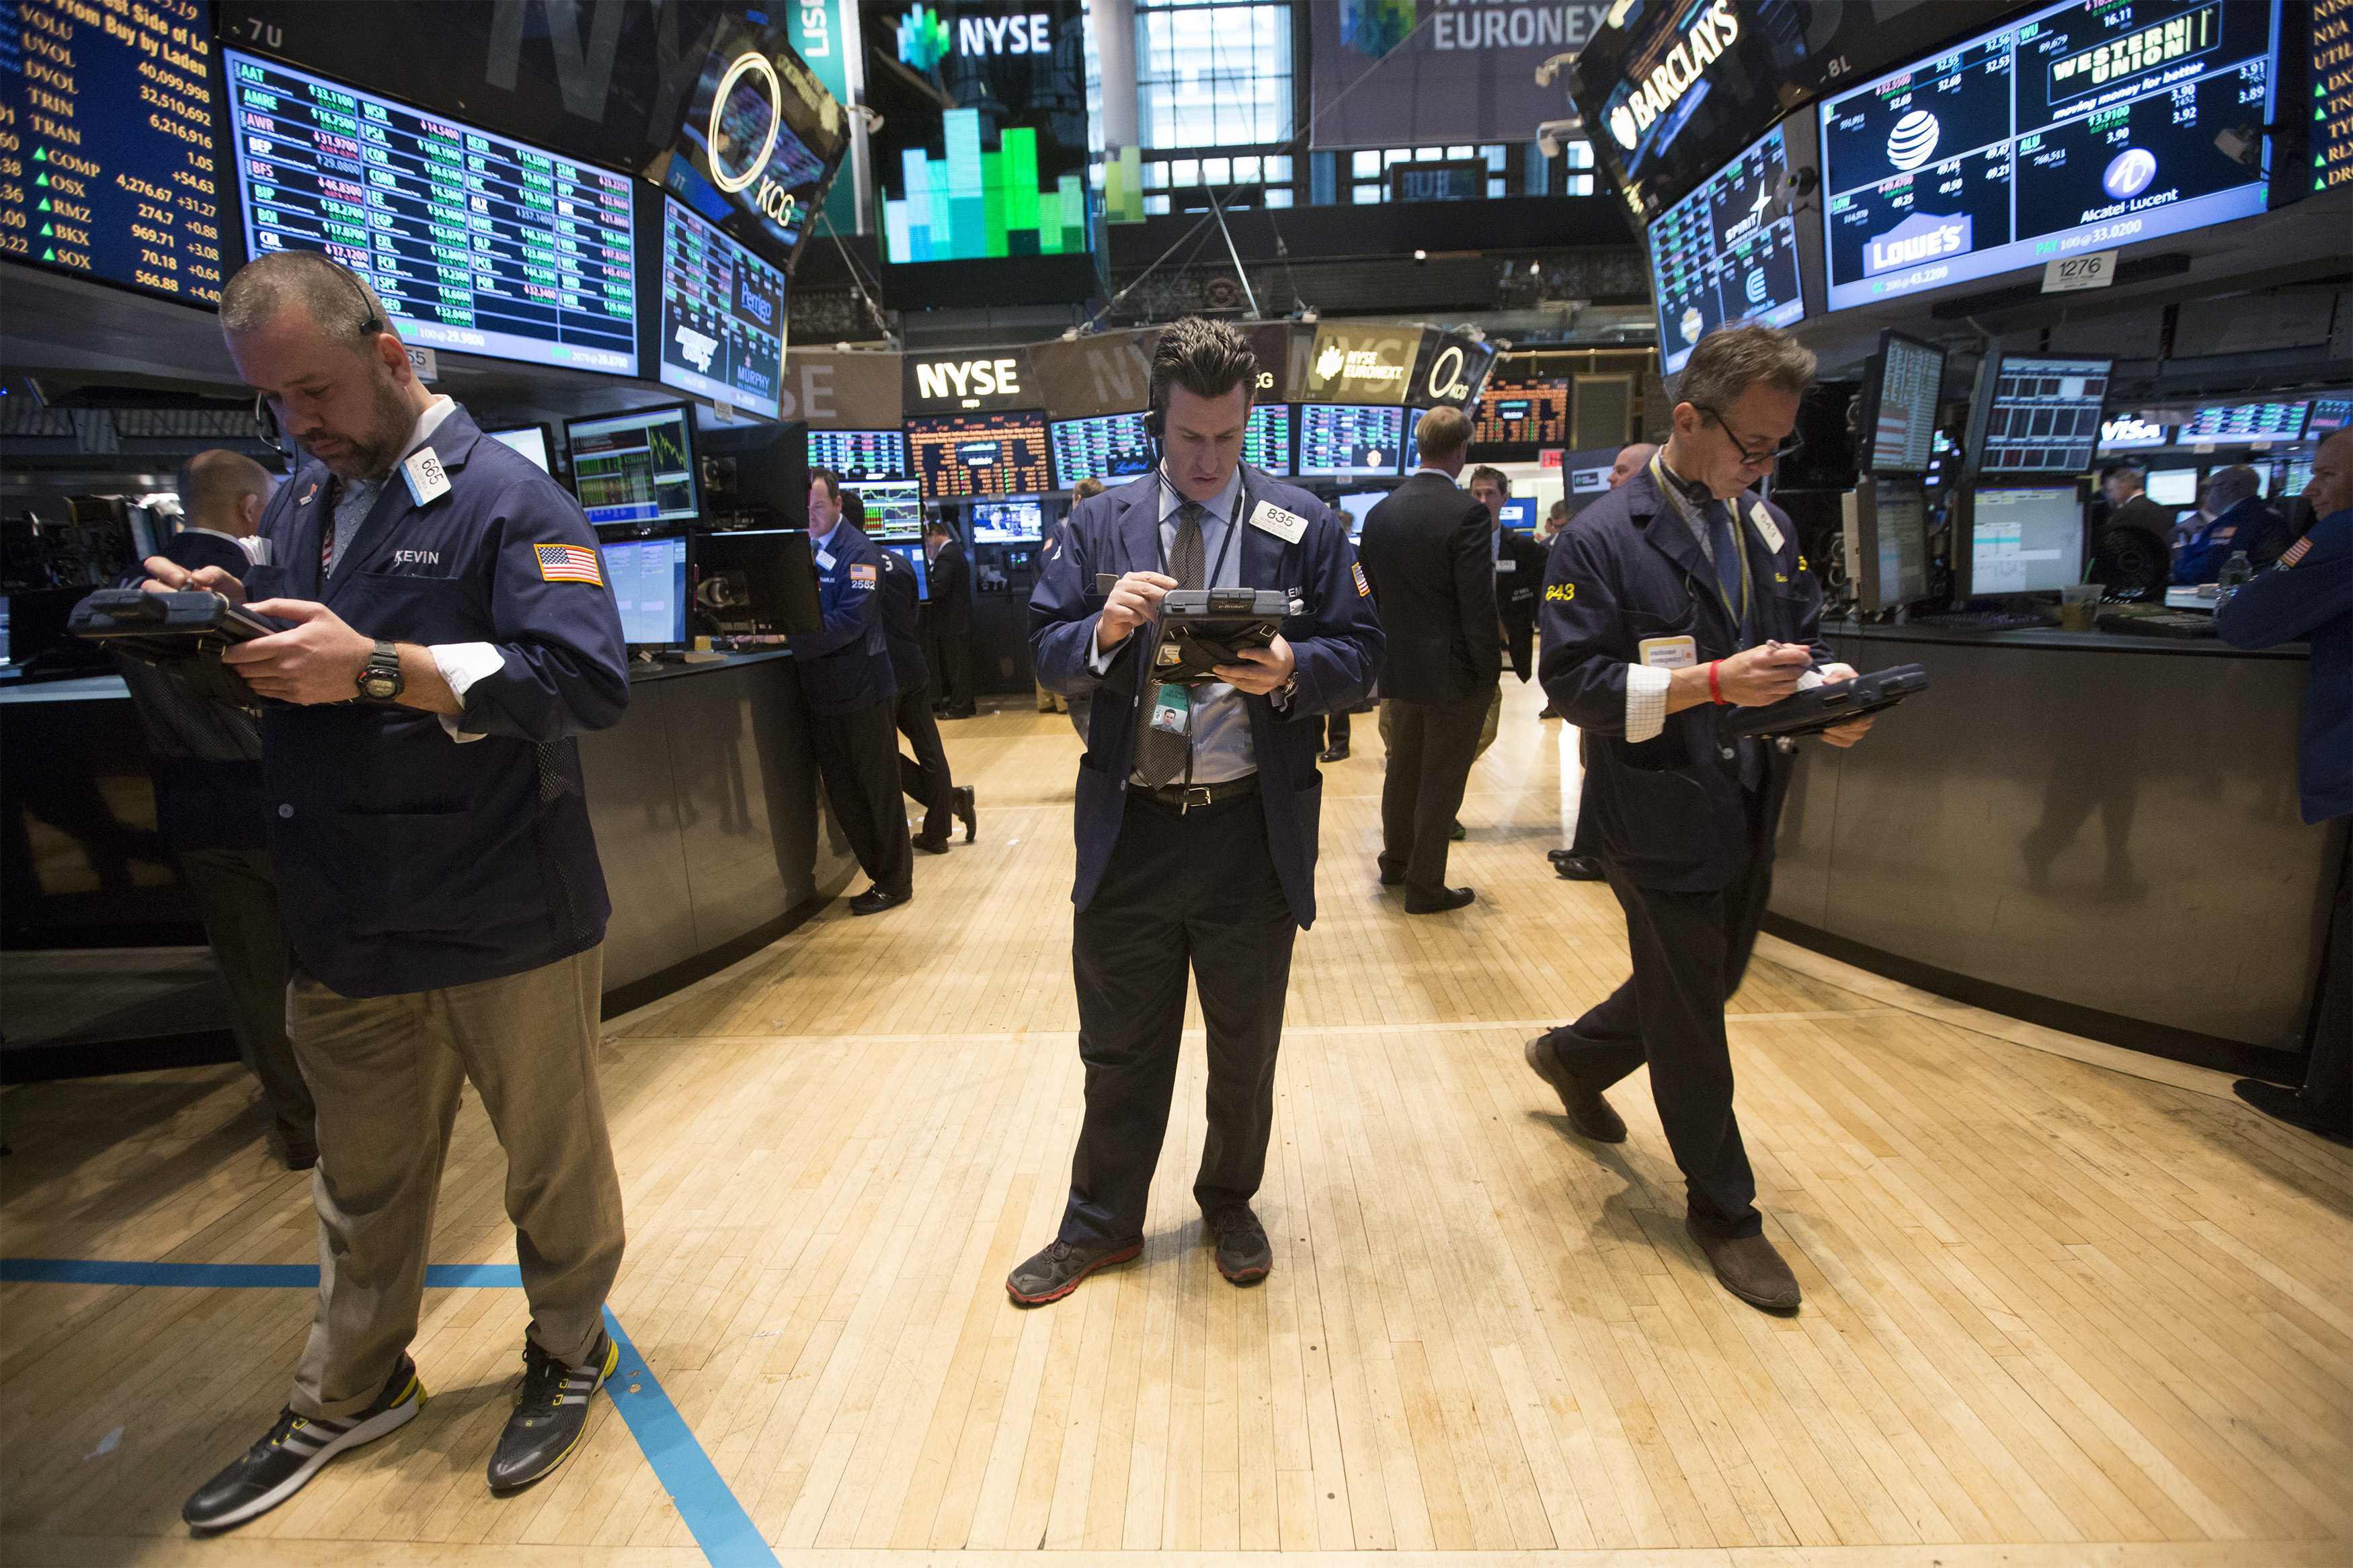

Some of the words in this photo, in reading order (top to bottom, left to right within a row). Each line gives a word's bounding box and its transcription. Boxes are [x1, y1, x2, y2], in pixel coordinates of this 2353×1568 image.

[133, 3, 169, 35] Side
[171, 27, 188, 45] of
[2020, 22, 2040, 40] WU
[2103, 7, 2132, 28] 16.11
[105, 14, 136, 47] Buy
[139, 31, 159, 57] by
[163, 42, 207, 78] Laden
[959, 13, 1051, 57] NYSE
[2313, 18, 2350, 46] NYA
[2052, 17, 2187, 82] WESTERN
[2091, 37, 2186, 85] UNION
[22, 31, 77, 68] UVOL
[140, 85, 211, 127] 32,510,692
[241, 64, 265, 83] AAT
[1628, 0, 1739, 132] BARCLAYS
[2239, 61, 2265, 79] 3.91
[24, 58, 79, 95] DVOL
[149, 114, 212, 150] 6,216,916
[243, 88, 278, 110] AMRE
[2052, 96, 2097, 121] moving
[2098, 83, 2141, 108] money
[2142, 73, 2161, 92] for
[2162, 61, 2204, 84] better
[2170, 84, 2196, 102] 3.90
[2238, 85, 2266, 104] 3.89
[27, 85, 74, 118] TRIN
[187, 151, 214, 172] 1.05
[247, 112, 275, 132] AWR
[2172, 106, 2198, 124] 3.92
[248, 136, 273, 155] BEP
[2020, 134, 2040, 152] ALU
[2106, 127, 2130, 145] 3.90
[30, 113, 81, 146] TRAN
[172, 171, 215, 195] +54.63
[251, 161, 274, 177] BFS
[48, 149, 101, 178] COMP
[116, 173, 173, 203] 4,276.67
[177, 197, 216, 218] +31.27
[254, 184, 276, 201] BIP
[50, 175, 86, 199] OSX
[138, 203, 174, 226] 274.7
[755, 175, 795, 227] KCG
[53, 199, 93, 224] RMZ
[130, 224, 175, 248] 969.71
[186, 243, 220, 262] +3.08
[1724, 212, 1758, 243] SPIRIT
[55, 223, 91, 247] BKX
[141, 249, 177, 271] 70.18
[188, 264, 221, 284] +0.64
[1872, 224, 1964, 270] LOWE'S
[56, 248, 92, 270] SOX
[135, 270, 180, 293] 566.88
[2059, 257, 2102, 278] 1276
[1346, 350, 1378, 366] NYSE
[737, 364, 770, 392] MURPHY
[916, 358, 1021, 399] NYSE
[422, 458, 444, 485] 665
[1267, 508, 1295, 527] 835
[394, 550, 439, 566] KEVIN
